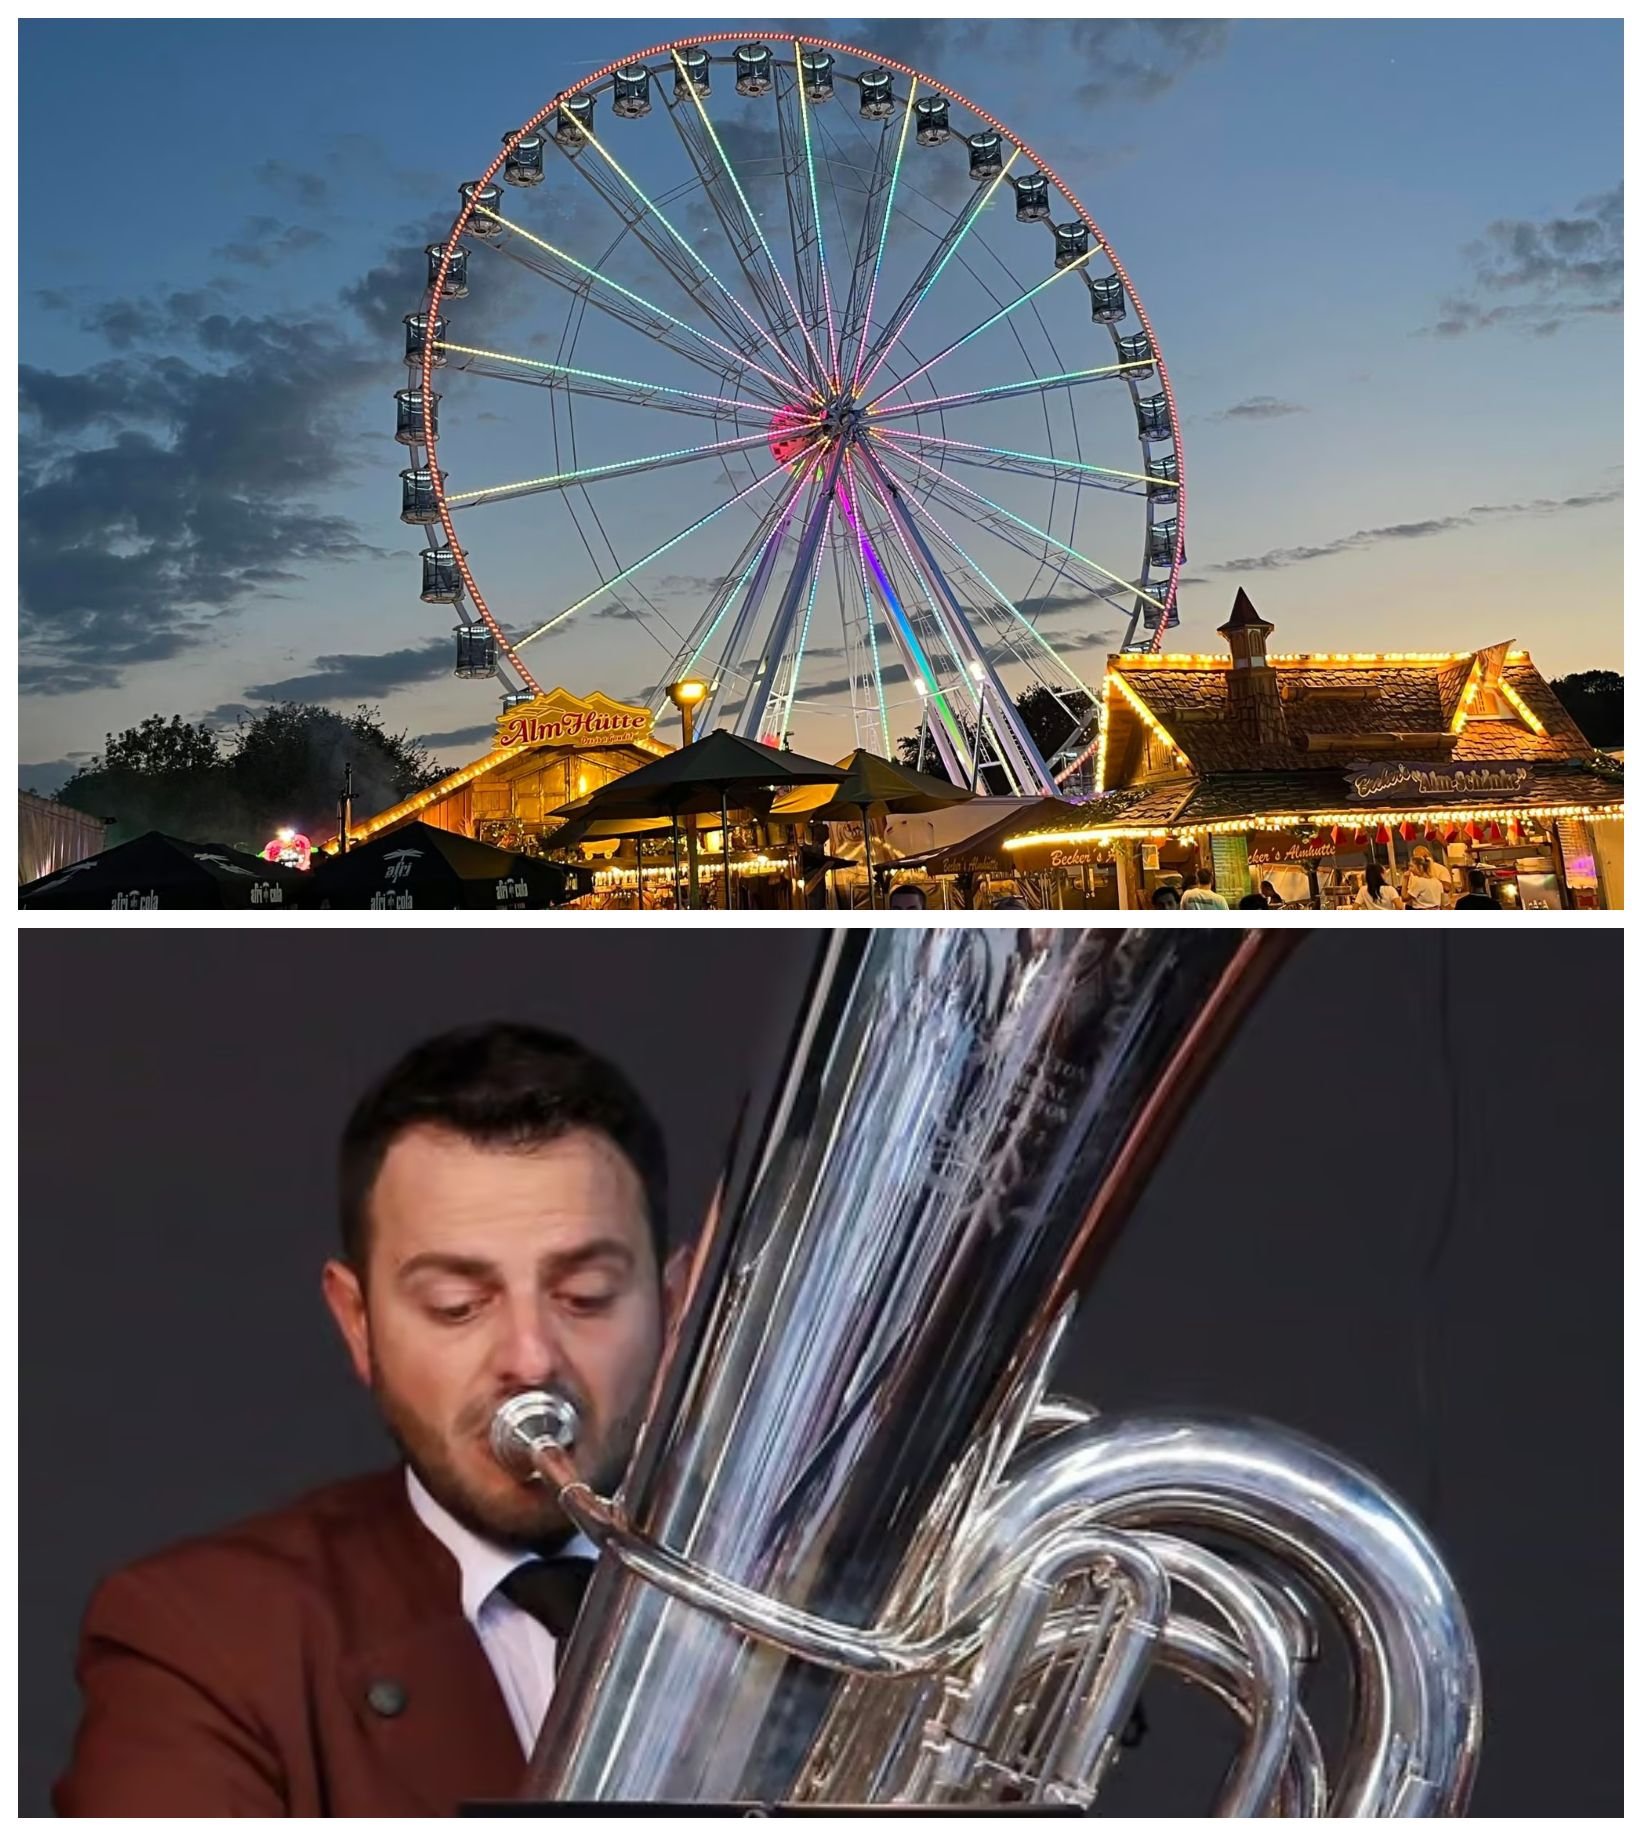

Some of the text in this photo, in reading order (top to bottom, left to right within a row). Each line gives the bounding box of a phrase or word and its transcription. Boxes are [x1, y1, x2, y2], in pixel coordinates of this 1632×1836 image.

[385, 861, 413, 884] afri
[111, 889, 159, 910] afri cola
[250, 882, 263, 904] afri
[370, 889, 413, 910] afri cola
[496, 879, 509, 900] afri
